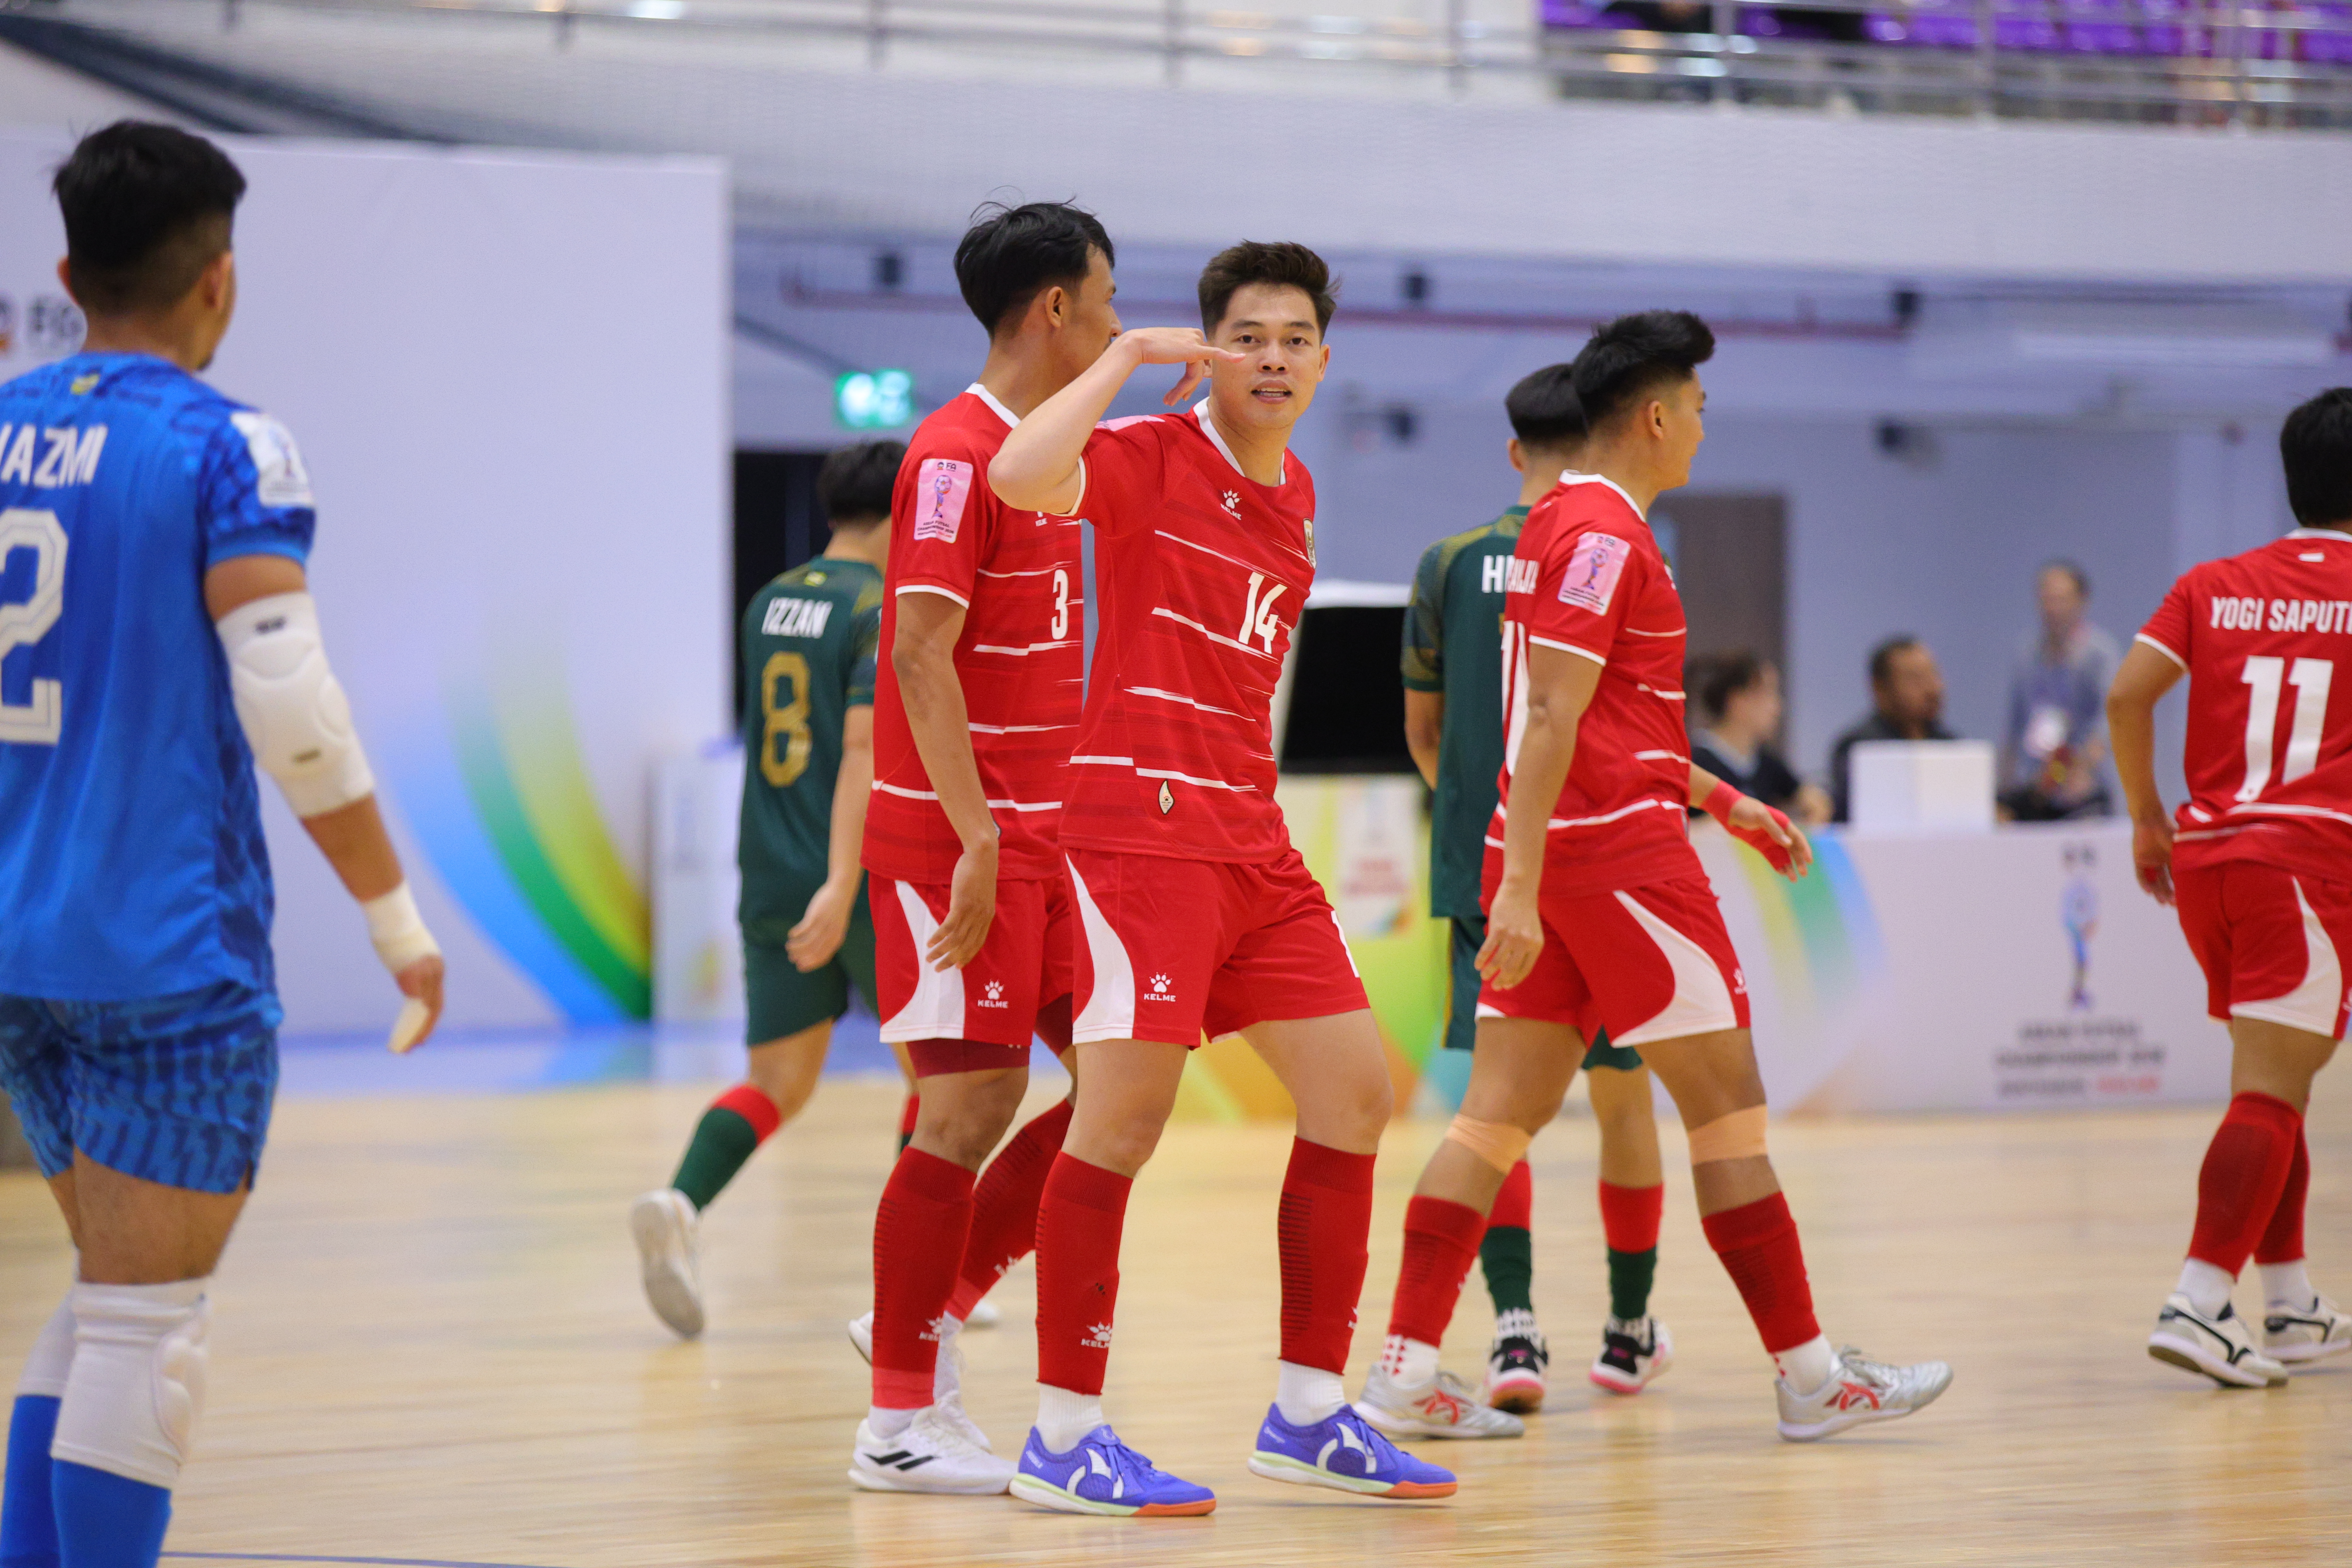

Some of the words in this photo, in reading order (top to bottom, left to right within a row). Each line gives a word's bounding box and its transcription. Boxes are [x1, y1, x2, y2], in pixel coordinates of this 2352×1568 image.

[1220, 503, 1242, 520] KELME
[762, 597, 833, 639] IZZAN
[1051, 569, 1069, 640] 3
[1238, 571, 1288, 654] 14
[2210, 596, 2265, 632] YOGI
[759, 651, 813, 788] 8
[2233, 655, 2334, 802] 11
[977, 999, 1009, 1009] KELME
[1143, 993, 1176, 1002] KELME
